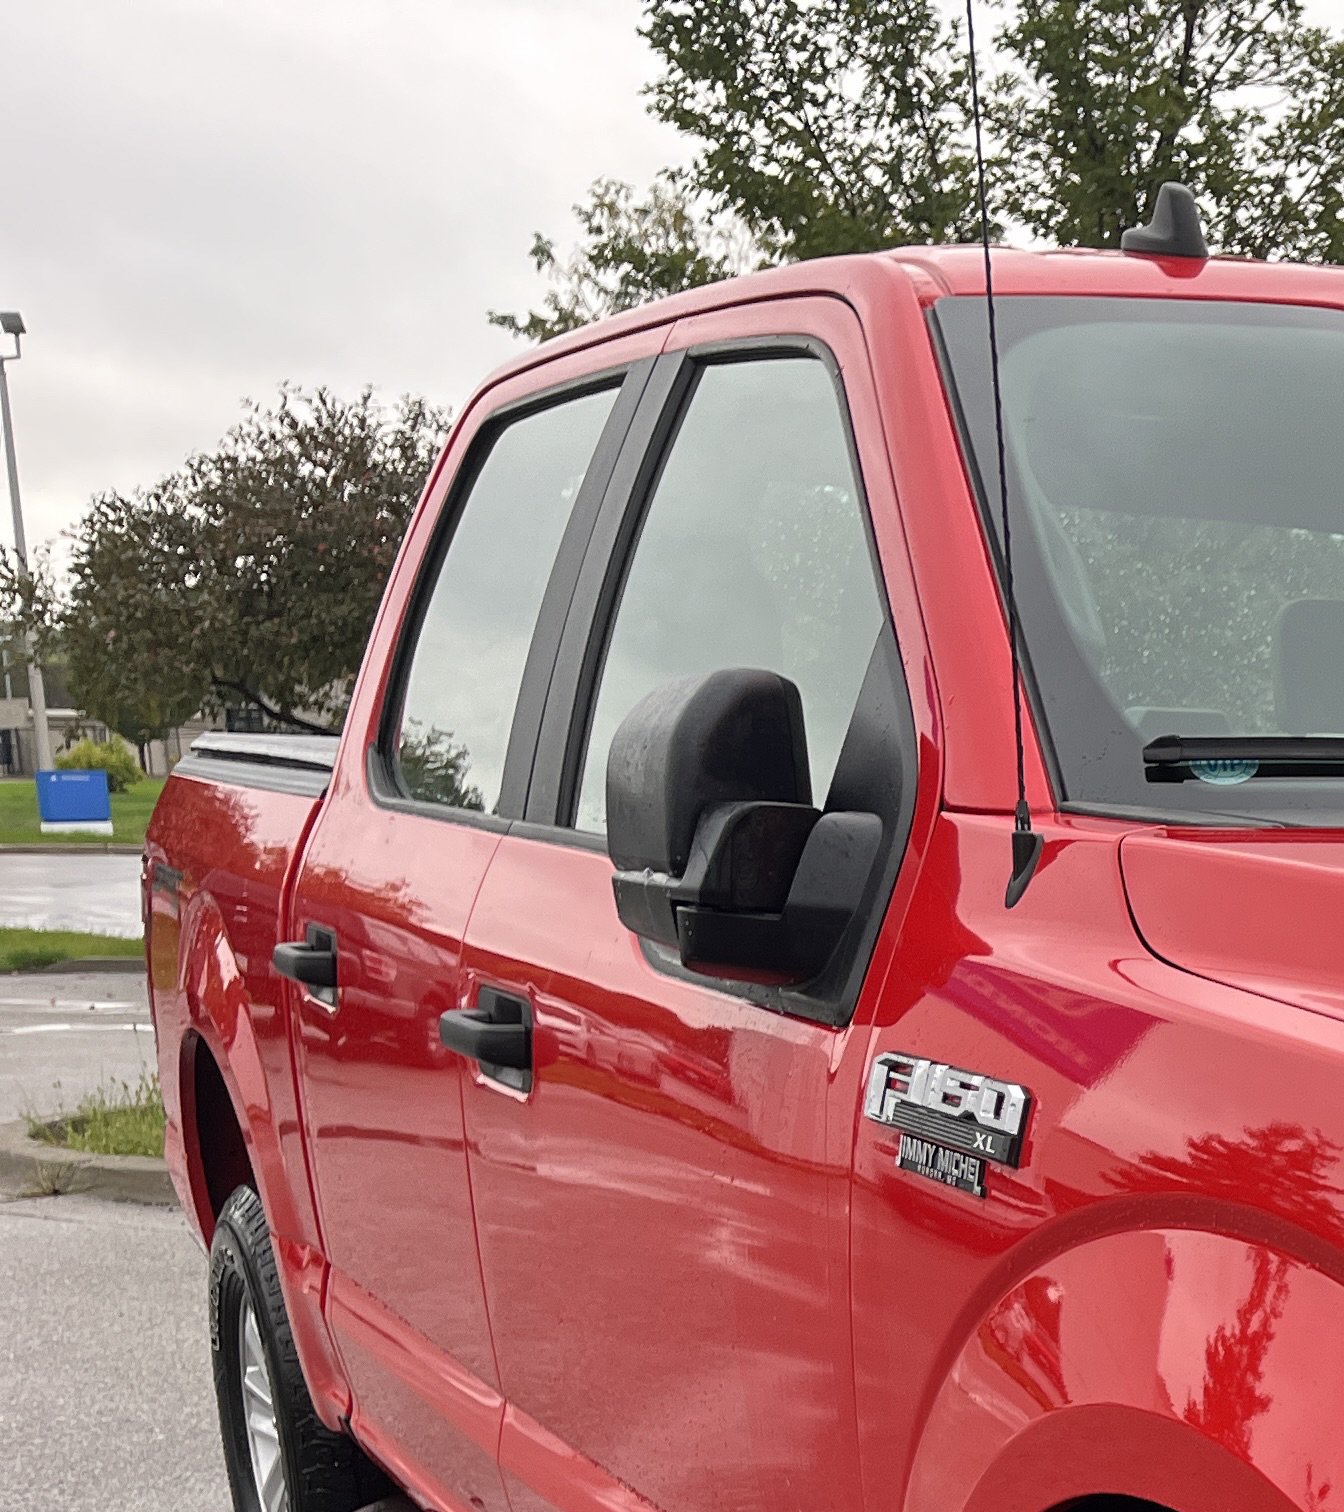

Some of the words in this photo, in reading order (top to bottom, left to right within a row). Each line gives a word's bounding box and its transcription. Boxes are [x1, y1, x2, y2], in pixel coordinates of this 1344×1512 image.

[973, 1132, 996, 1154] XL
[896, 1134, 936, 1168] JIMMY
[937, 1146, 982, 1196] MICHEL
